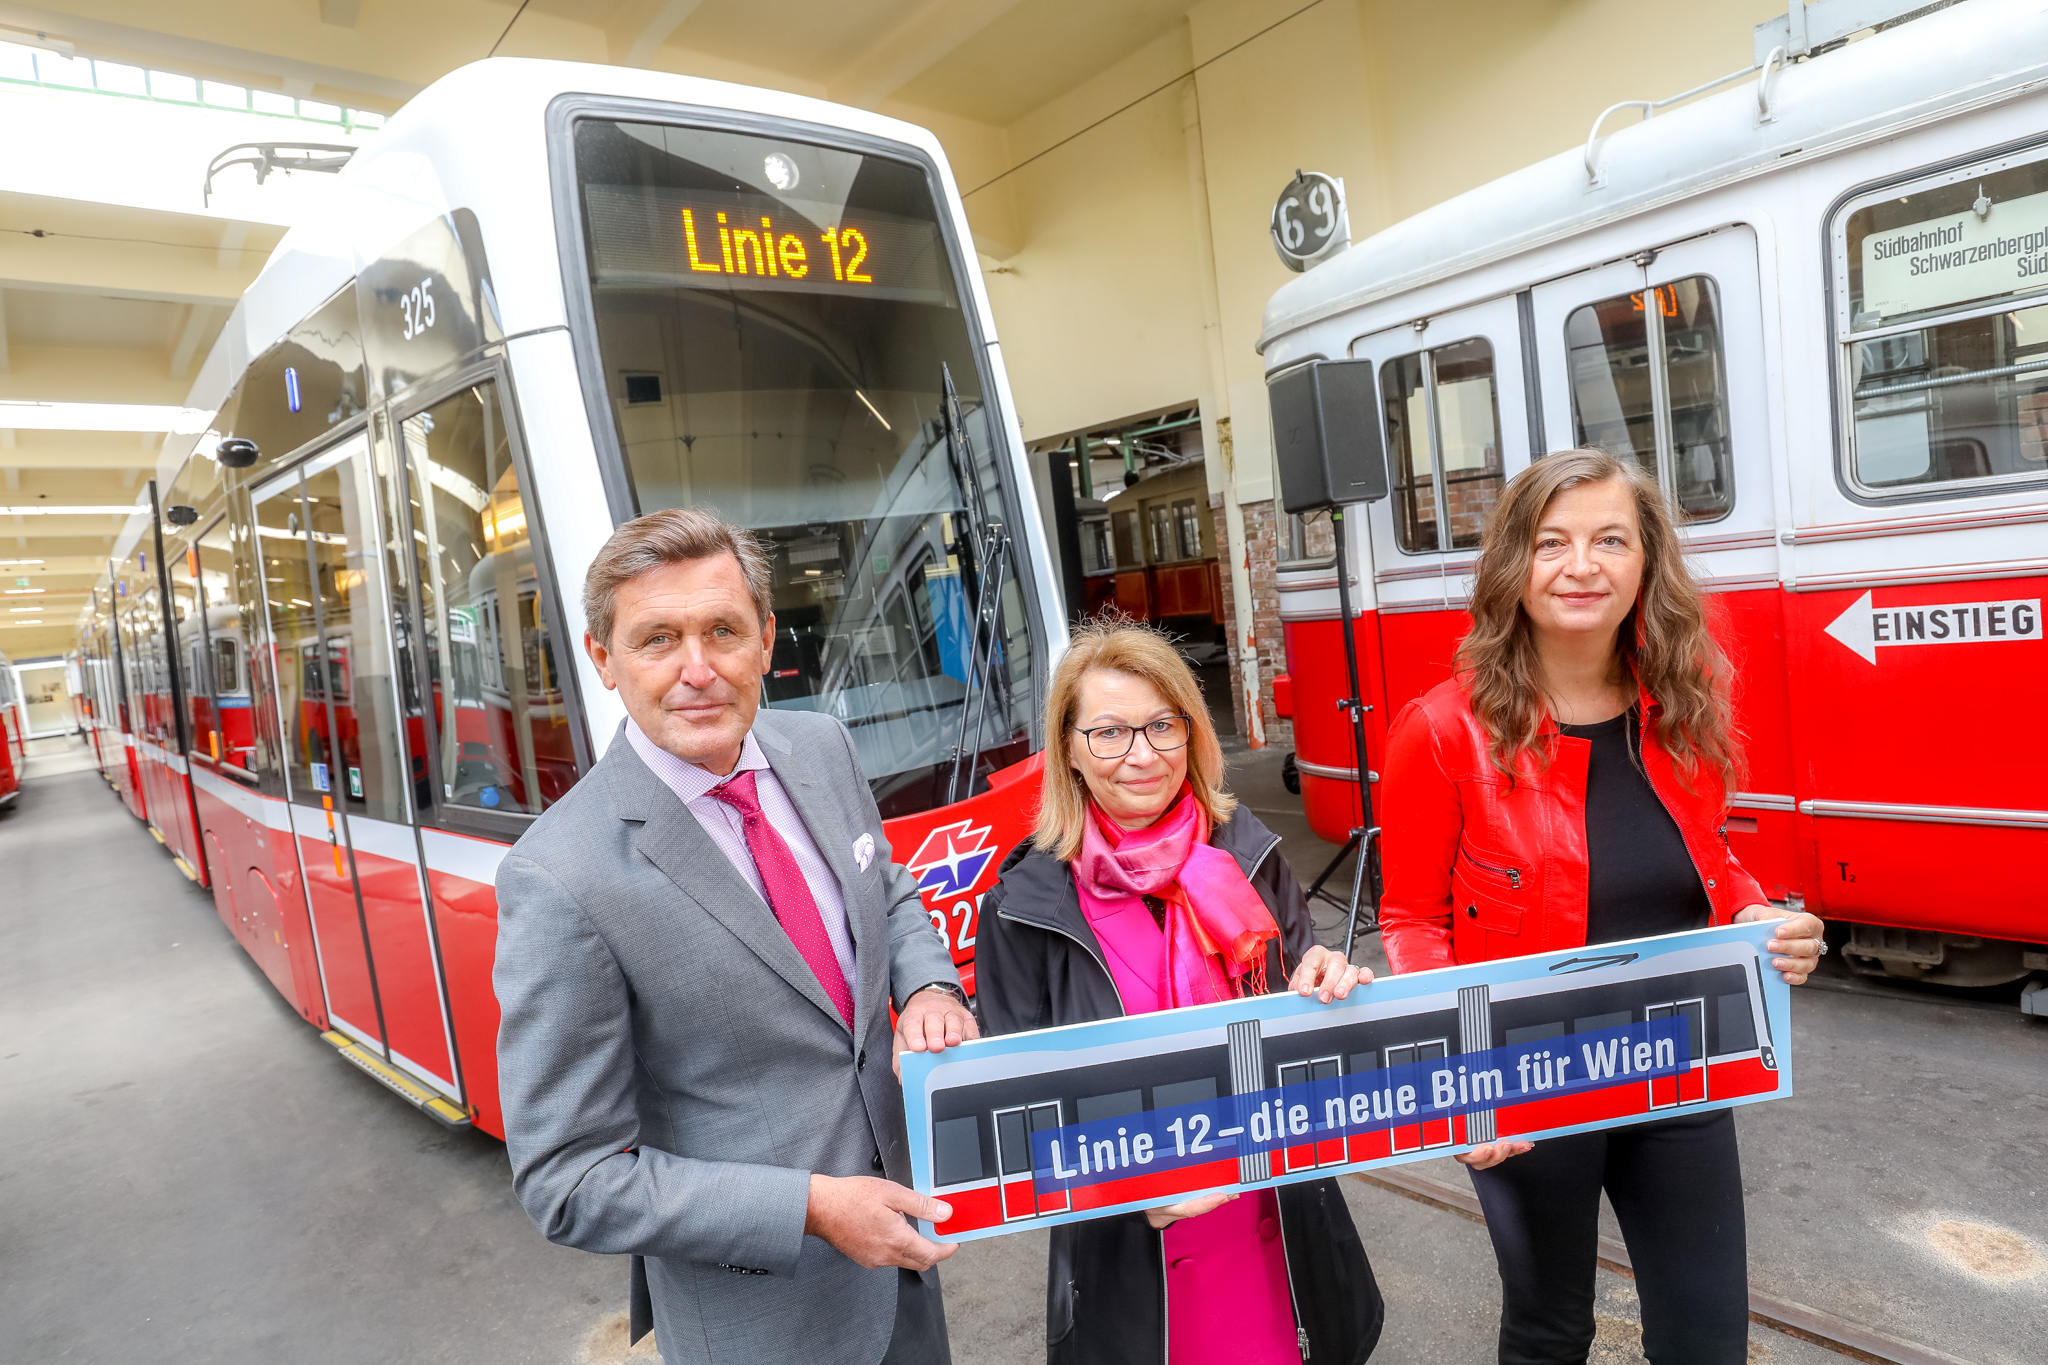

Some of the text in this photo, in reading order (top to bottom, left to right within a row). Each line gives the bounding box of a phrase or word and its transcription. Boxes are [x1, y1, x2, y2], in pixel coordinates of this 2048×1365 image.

[682, 208, 873, 283] Linie 12
[1279, 183, 1336, 249] 69
[1874, 221, 1964, 261] Südbahnhof
[2017, 252, 2048, 278] Süd
[401, 277, 435, 340] 325
[1873, 604, 2034, 641] EINSTIEG
[929, 893, 986, 951] 32
[1051, 1127, 1155, 1180] Linie
[1325, 1084, 1416, 1129] neue
[1431, 1066, 1504, 1109] Bim
[1517, 1050, 1571, 1094] für
[1582, 1036, 1675, 1082] Wien
